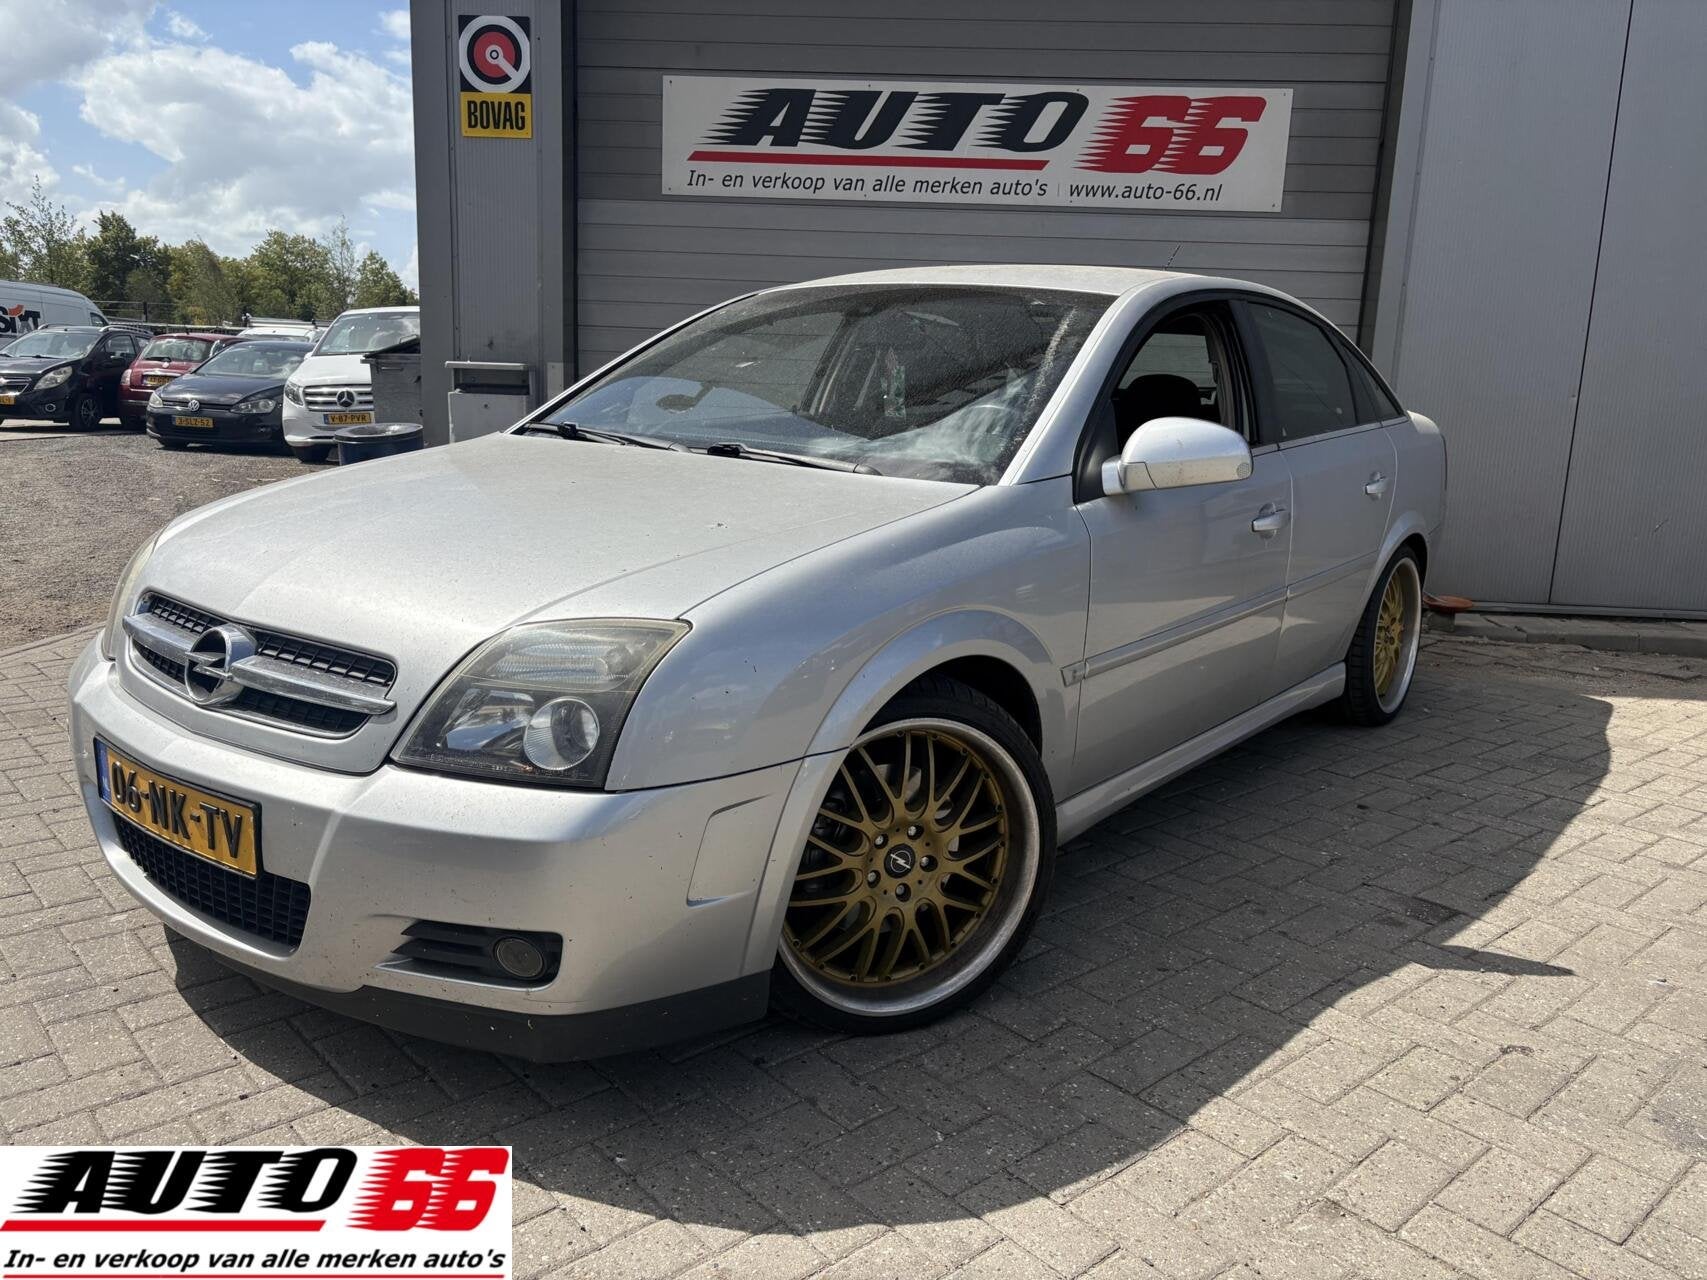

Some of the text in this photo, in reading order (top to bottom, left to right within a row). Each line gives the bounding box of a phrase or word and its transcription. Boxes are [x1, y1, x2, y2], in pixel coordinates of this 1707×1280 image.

[467, 100, 526, 131] BOVAG
[694, 88, 1268, 176] AUTO 66
[686, 169, 1048, 197] In- en verkoop van alle merken auto's
[1069, 183, 1223, 202] www.auto-66.nl
[111, 761, 243, 859] 06-NK-TV
